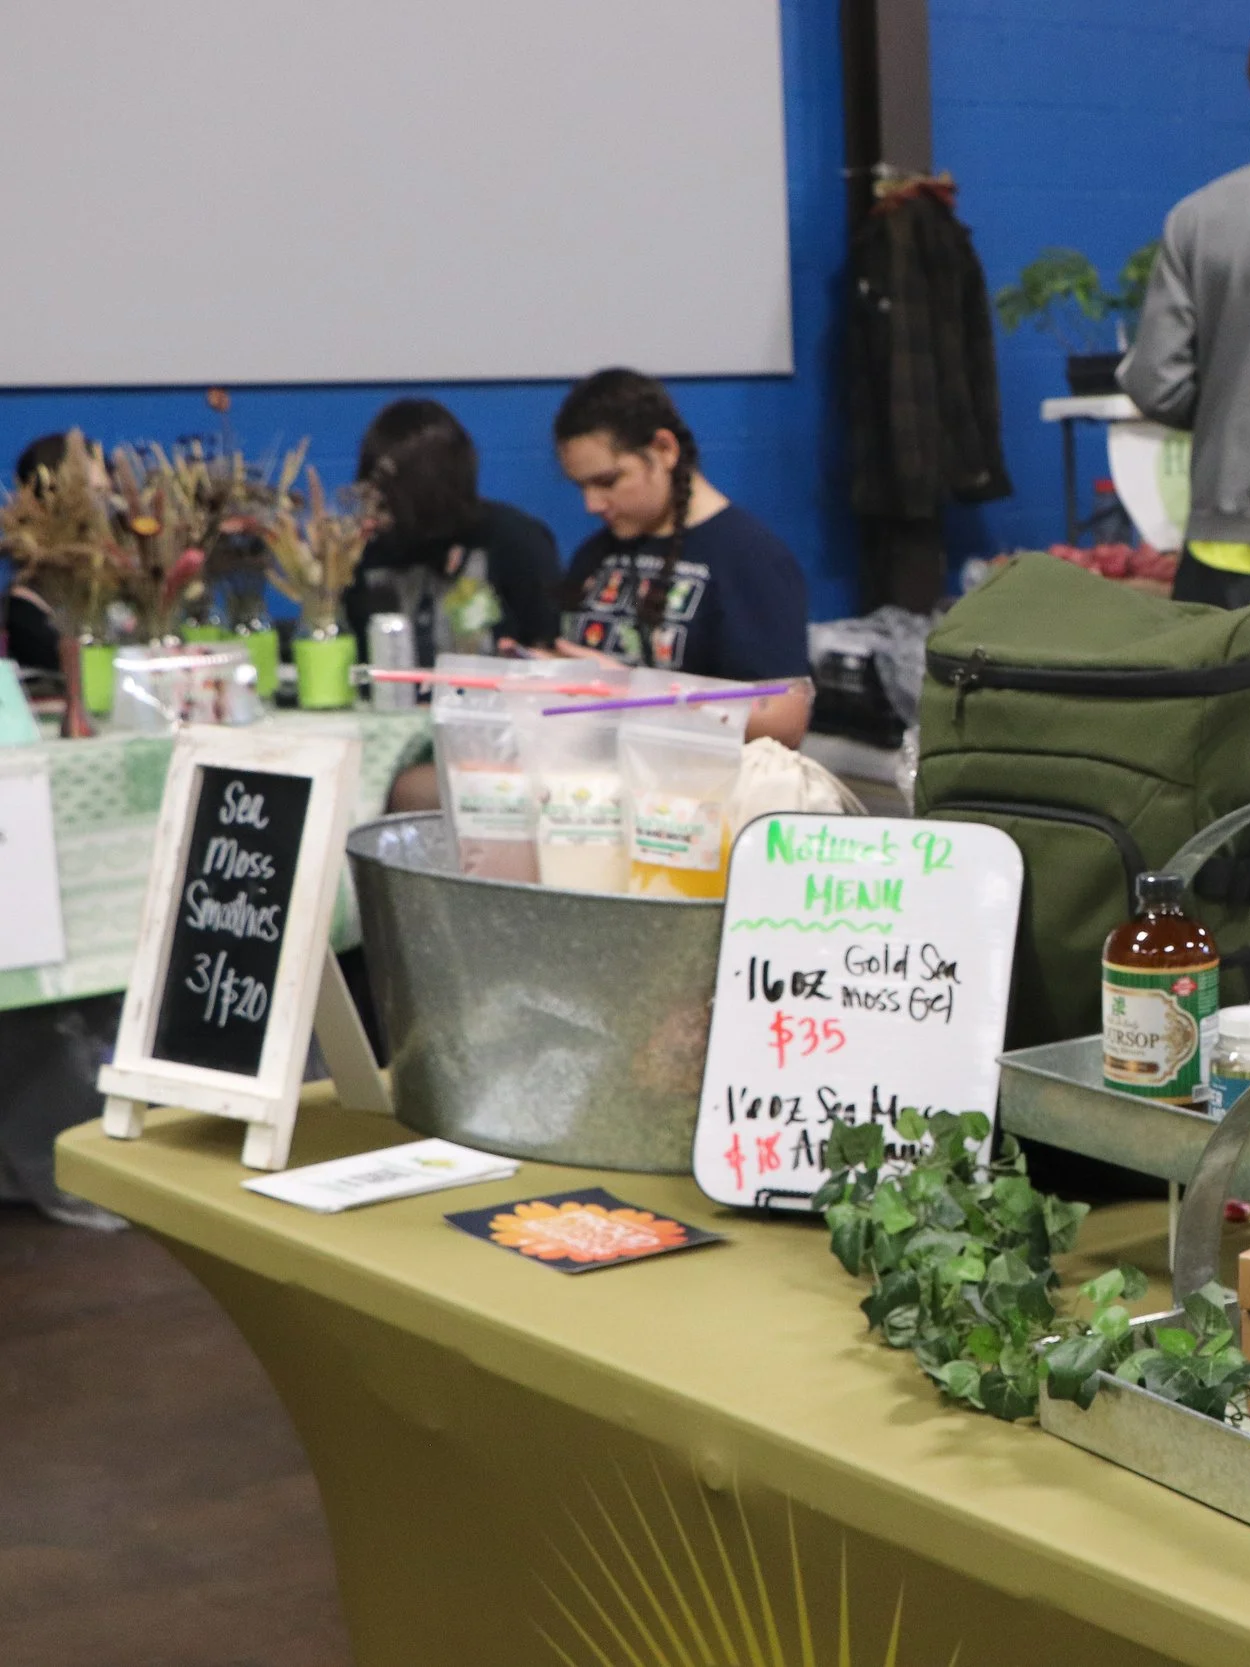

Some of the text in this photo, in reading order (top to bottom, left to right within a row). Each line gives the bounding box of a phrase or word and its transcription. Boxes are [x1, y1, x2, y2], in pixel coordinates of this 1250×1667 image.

[219, 780, 270, 830] Sea
[203, 837, 276, 880] Moss
[912, 832, 954, 874] 92
[804, 874, 905, 914] MENU
[845, 944, 910, 980] Gold
[921, 943, 962, 984] Sea
[185, 950, 268, 1028] 3/$20
[909, 986, 954, 1024] Gel
[768, 1010, 847, 1069] $35
